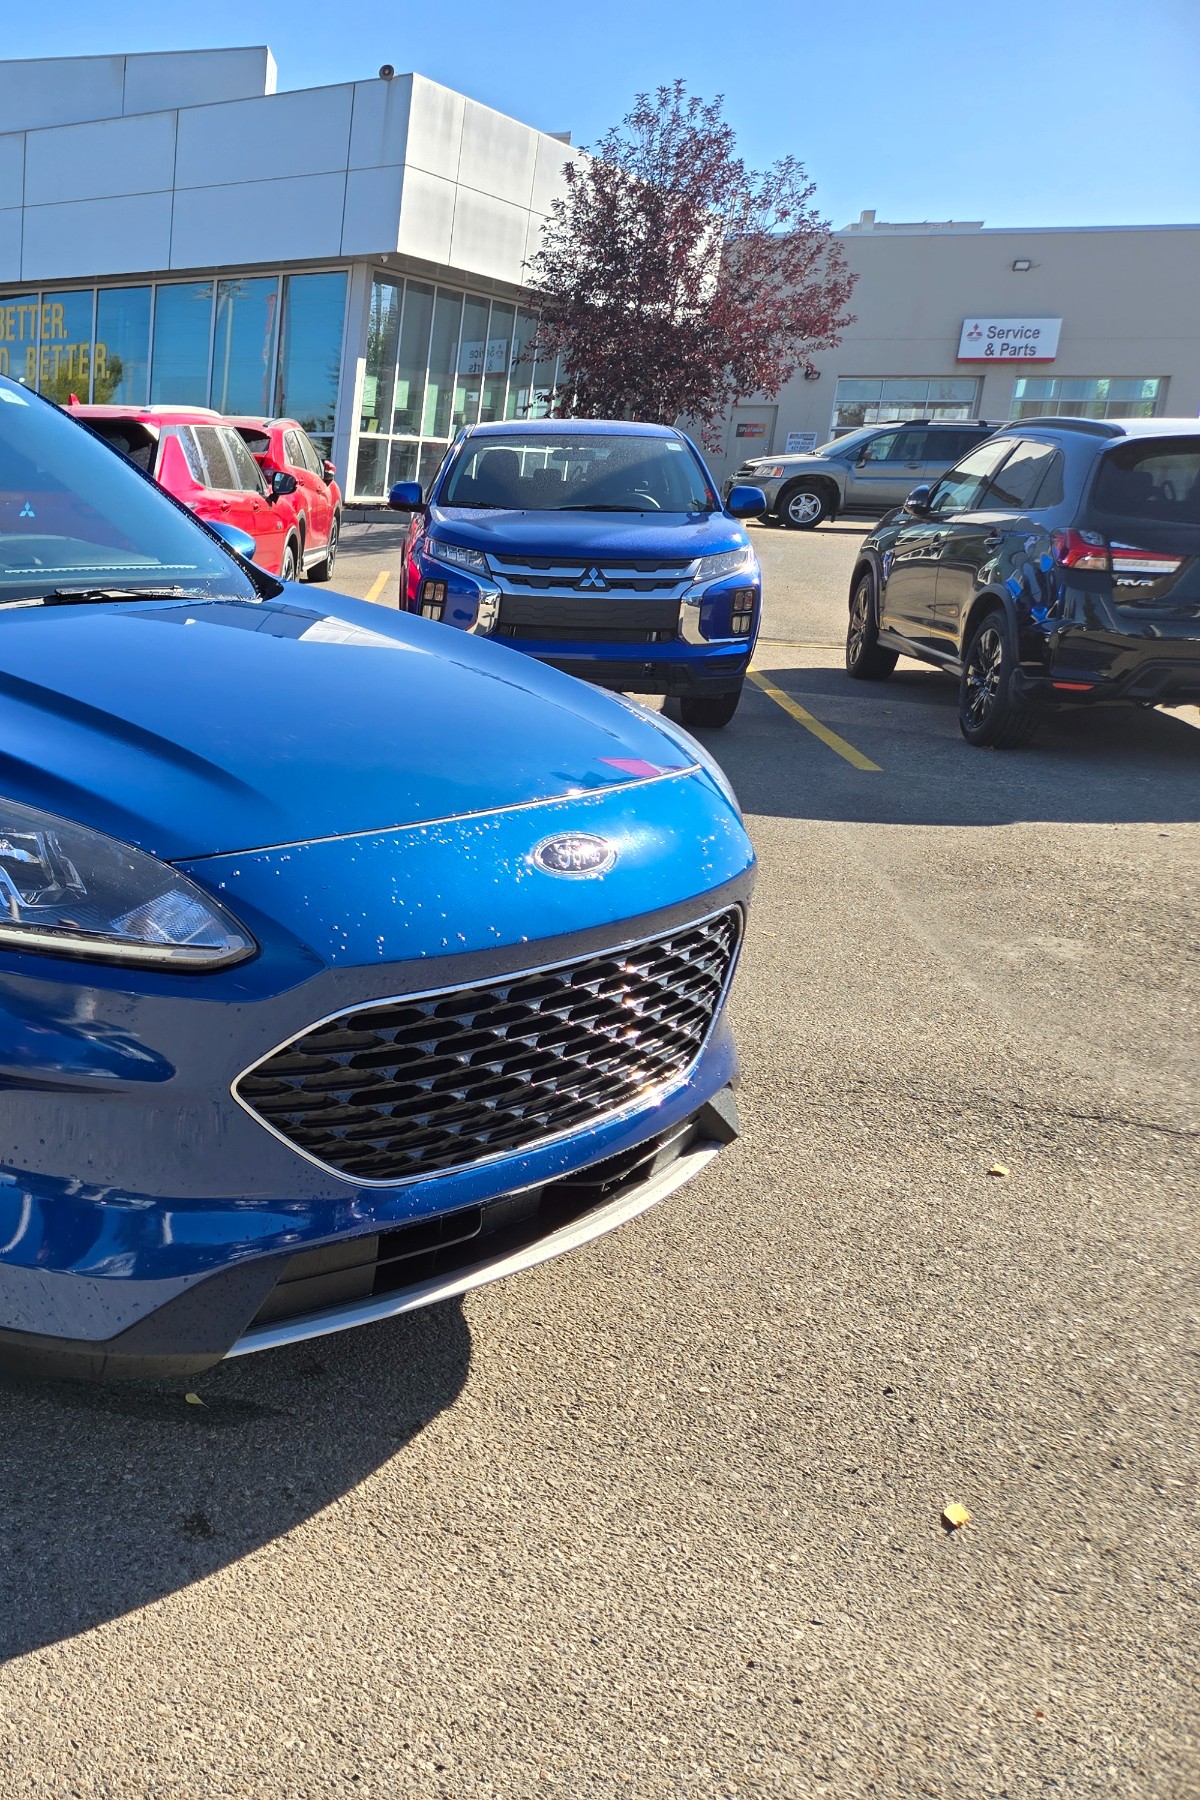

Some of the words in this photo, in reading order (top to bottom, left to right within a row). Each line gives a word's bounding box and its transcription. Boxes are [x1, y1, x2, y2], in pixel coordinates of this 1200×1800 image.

[986, 325, 1041, 340] Service
[984, 343, 995, 356] &
[999, 343, 1037, 356] Parts
[25, 341, 111, 381] BETTER.
[1116, 579, 1153, 587] RVR
